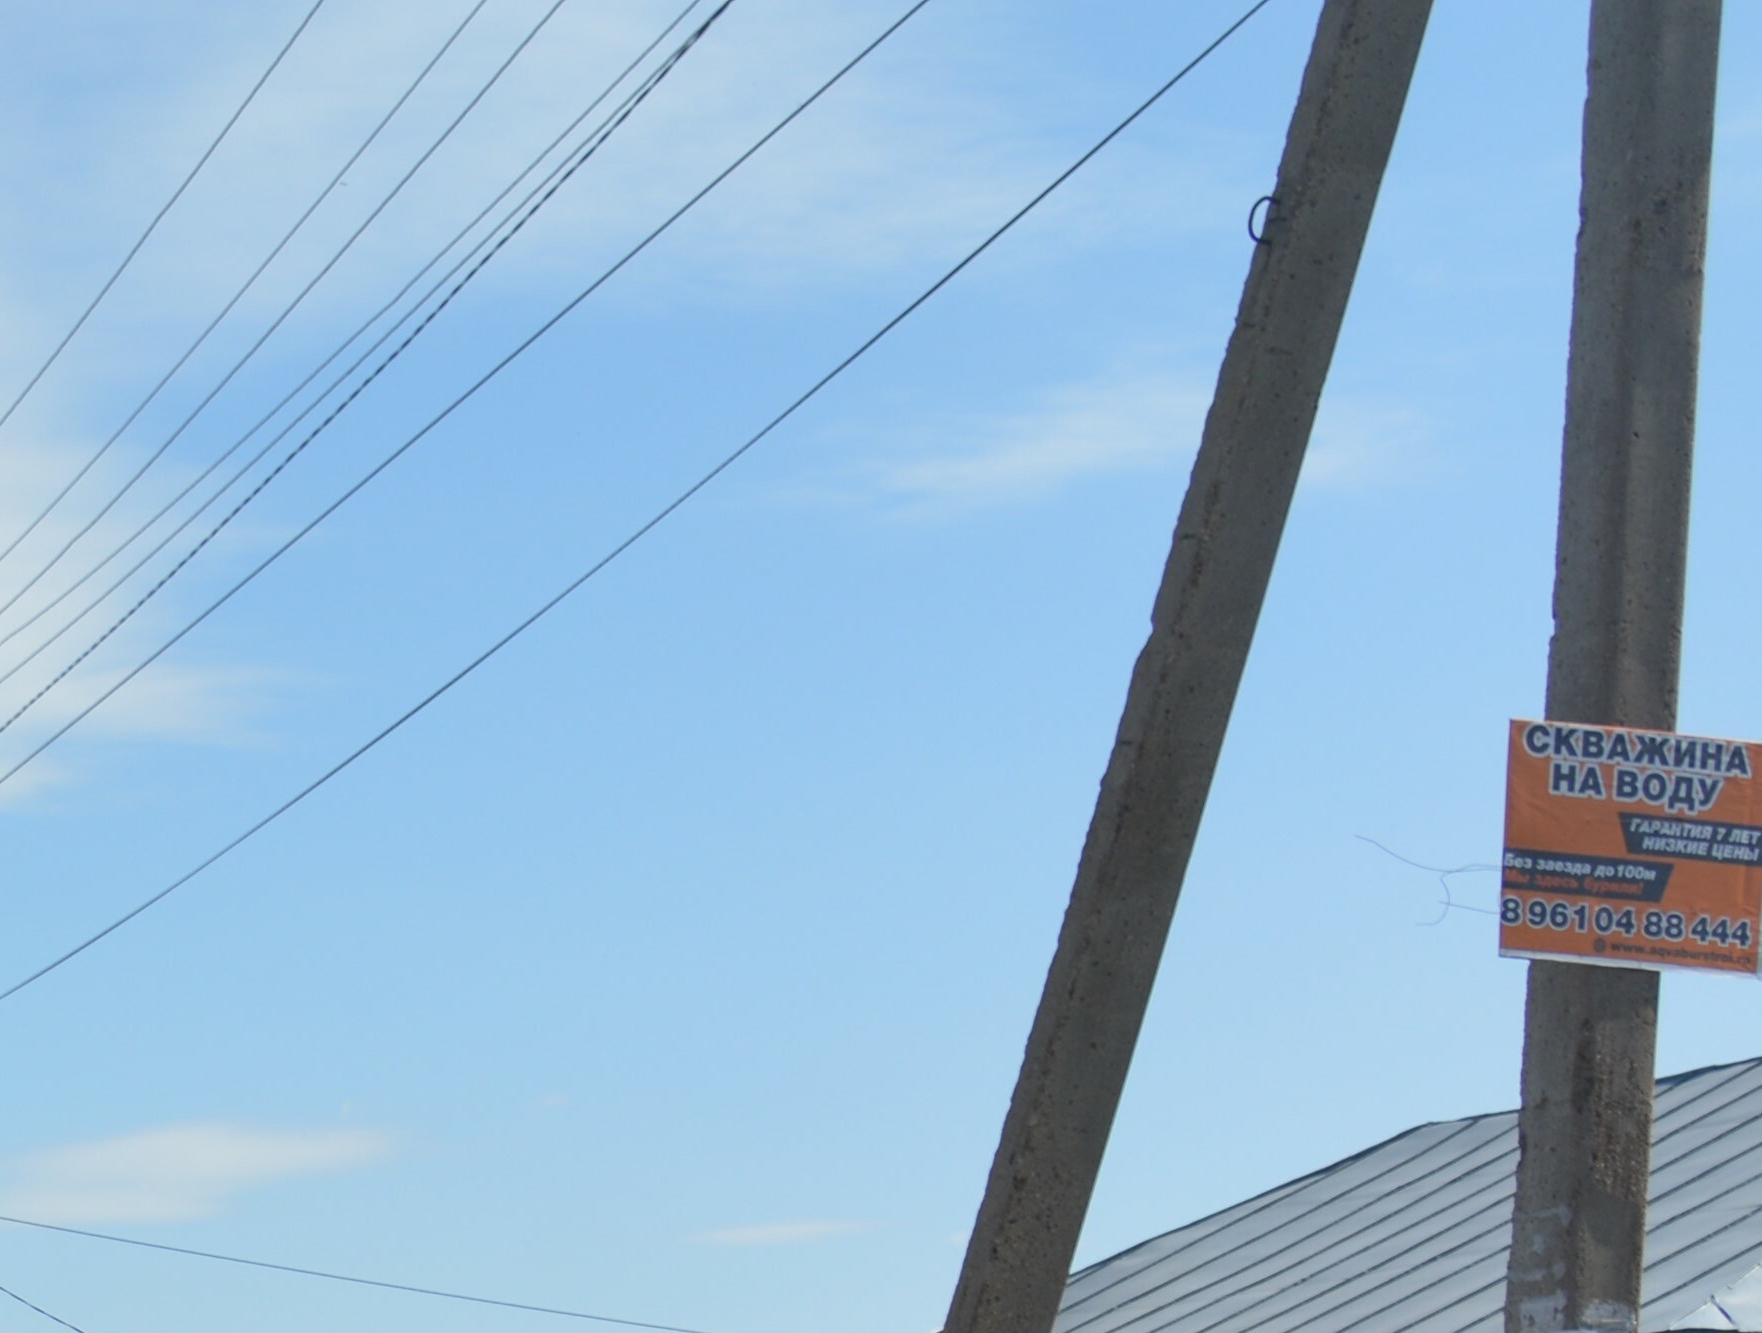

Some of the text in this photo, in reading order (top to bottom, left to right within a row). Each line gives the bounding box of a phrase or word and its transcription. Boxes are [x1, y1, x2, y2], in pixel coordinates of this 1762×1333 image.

[1525, 724, 1750, 777] СКВАЖИНА
[1550, 760, 1724, 815] НА ВОДУ
[1629, 817, 1762, 845] ГАРАНТИЯ 7 ЛЕТ
[1642, 836, 1760, 862] НИЗКИЕ ЦЕНЫ
[1503, 853, 1532, 869] Без
[1535, 858, 1590, 876] заезда
[1500, 896, 1523, 926] 8
[1642, 910, 1686, 942] 88
[1690, 914, 1751, 949] 444
